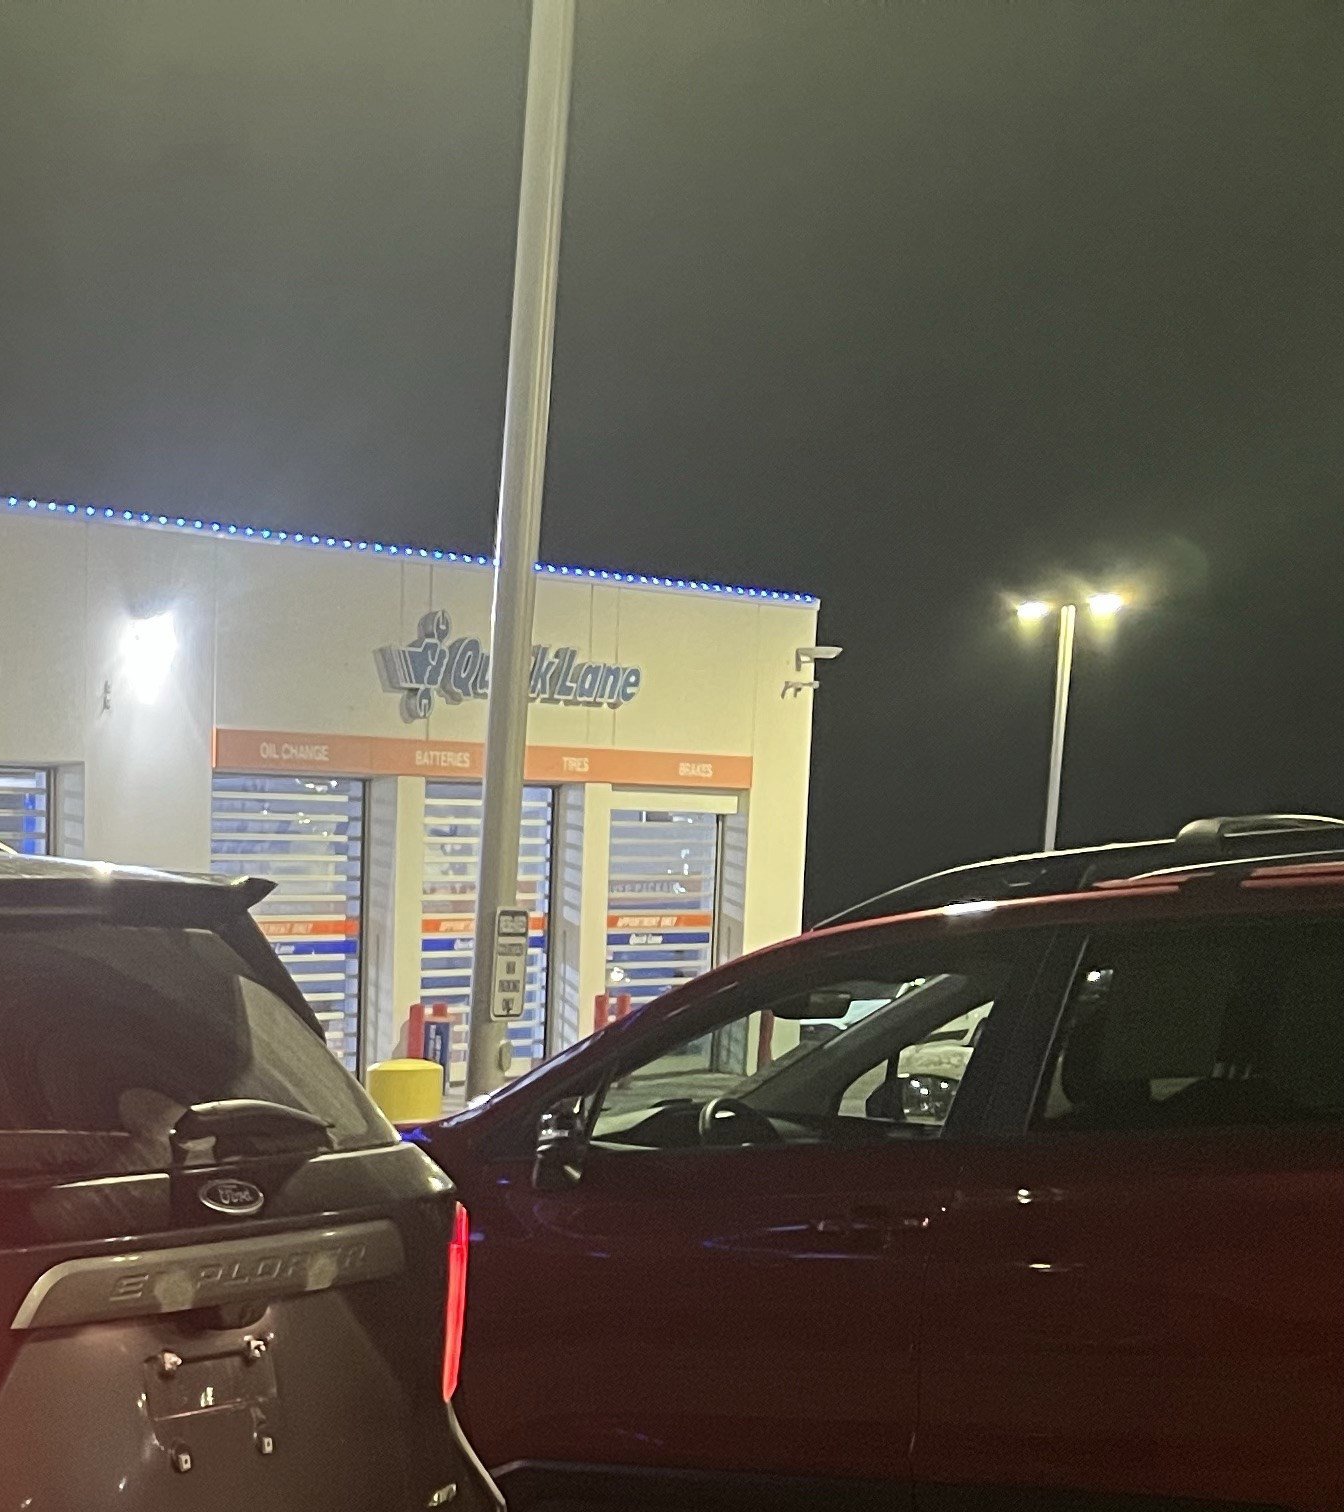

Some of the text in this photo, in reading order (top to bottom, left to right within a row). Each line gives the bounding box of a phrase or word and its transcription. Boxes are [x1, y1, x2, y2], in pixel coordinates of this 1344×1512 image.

[260, 742, 330, 761] OIL CHANGE
[415, 750, 471, 768] BATTERIES
[562, 756, 590, 773] TIRES
[678, 762, 713, 778] BRAKES
